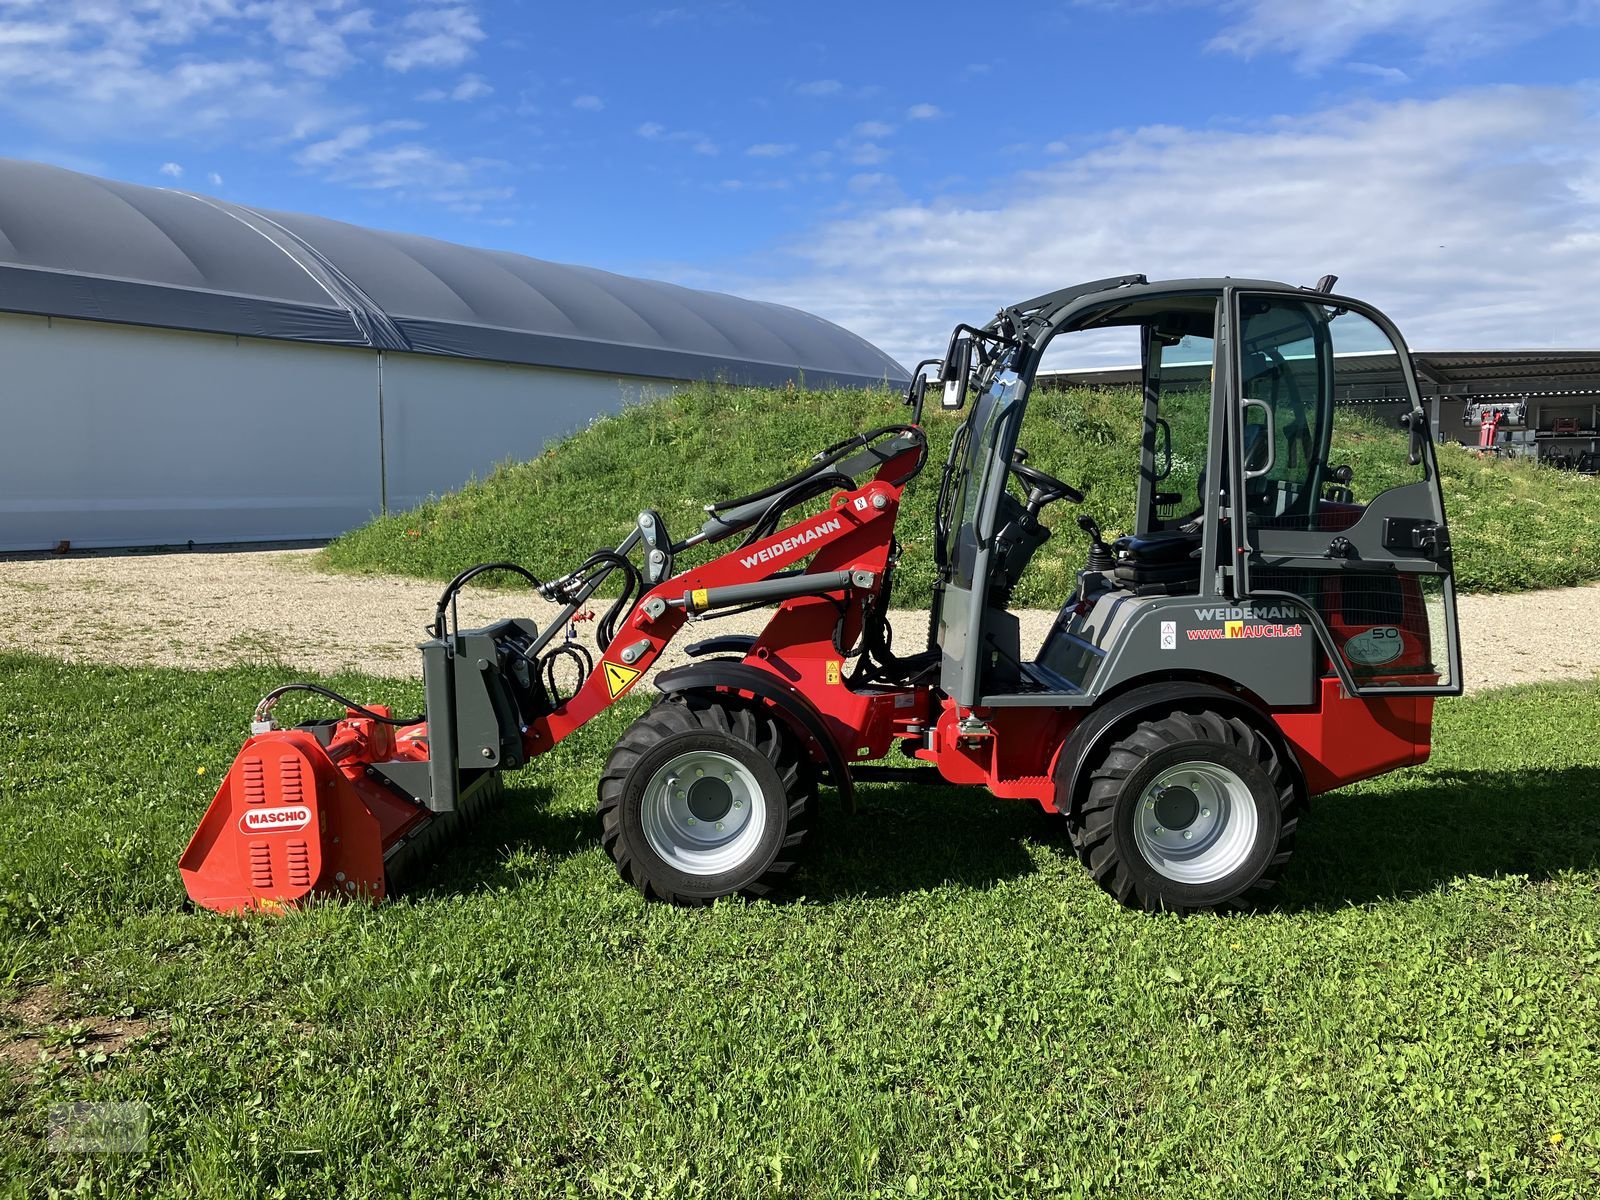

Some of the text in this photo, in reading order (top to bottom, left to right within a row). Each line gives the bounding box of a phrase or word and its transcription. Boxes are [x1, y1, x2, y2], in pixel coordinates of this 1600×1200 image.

[740, 518, 841, 568] WEIDEMANN
[1372, 628, 1399, 639] 50
[249, 811, 306, 824] MASCHIO
